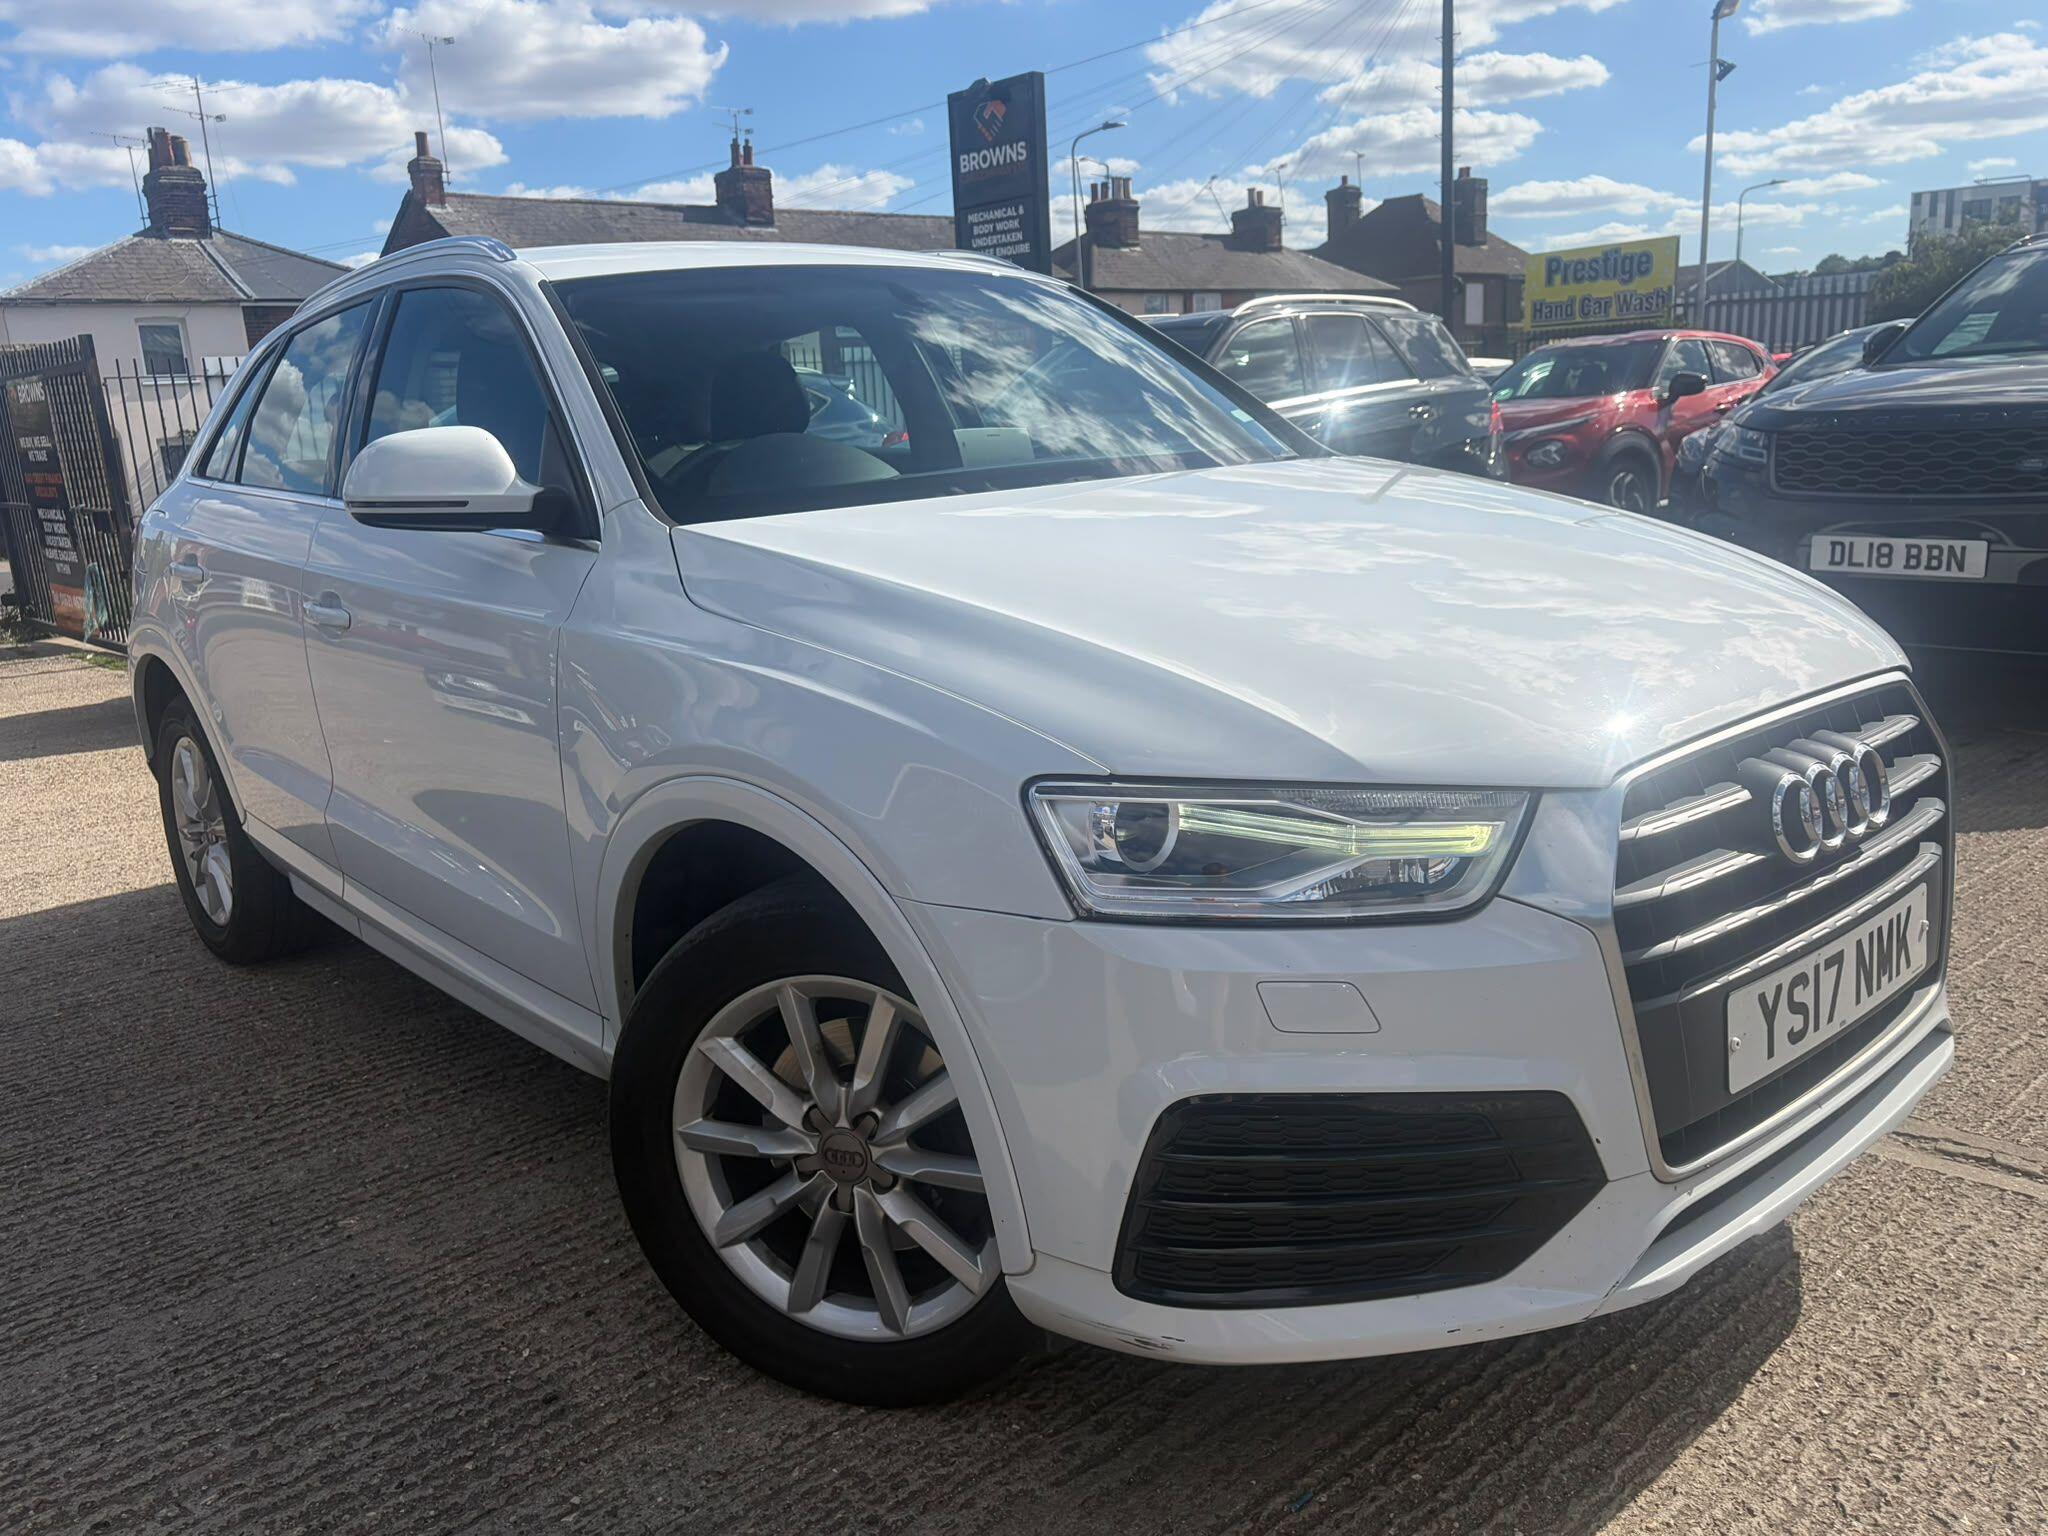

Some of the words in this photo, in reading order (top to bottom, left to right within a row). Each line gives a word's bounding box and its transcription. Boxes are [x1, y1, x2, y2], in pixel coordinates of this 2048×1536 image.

[959, 141, 1027, 174] BROWNS
[968, 206, 1018, 224] MECHANICAL
[1018, 204, 1025, 216] &
[972, 223, 994, 236] BODY
[995, 218, 1020, 231] WORK
[971, 231, 1023, 248] UNDERTAKEN
[996, 242, 1031, 257] ENQUIRE
[1544, 247, 1655, 288] Prestige
[1532, 295, 1576, 323] Hand
[1579, 293, 1613, 320] Car
[17, 381, 46, 404] BROWNS
[1828, 540, 1894, 569] DL18
[1903, 543, 1968, 573] BBN
[1757, 948, 1846, 1061] YS17
[1855, 904, 1912, 1007] NMK
